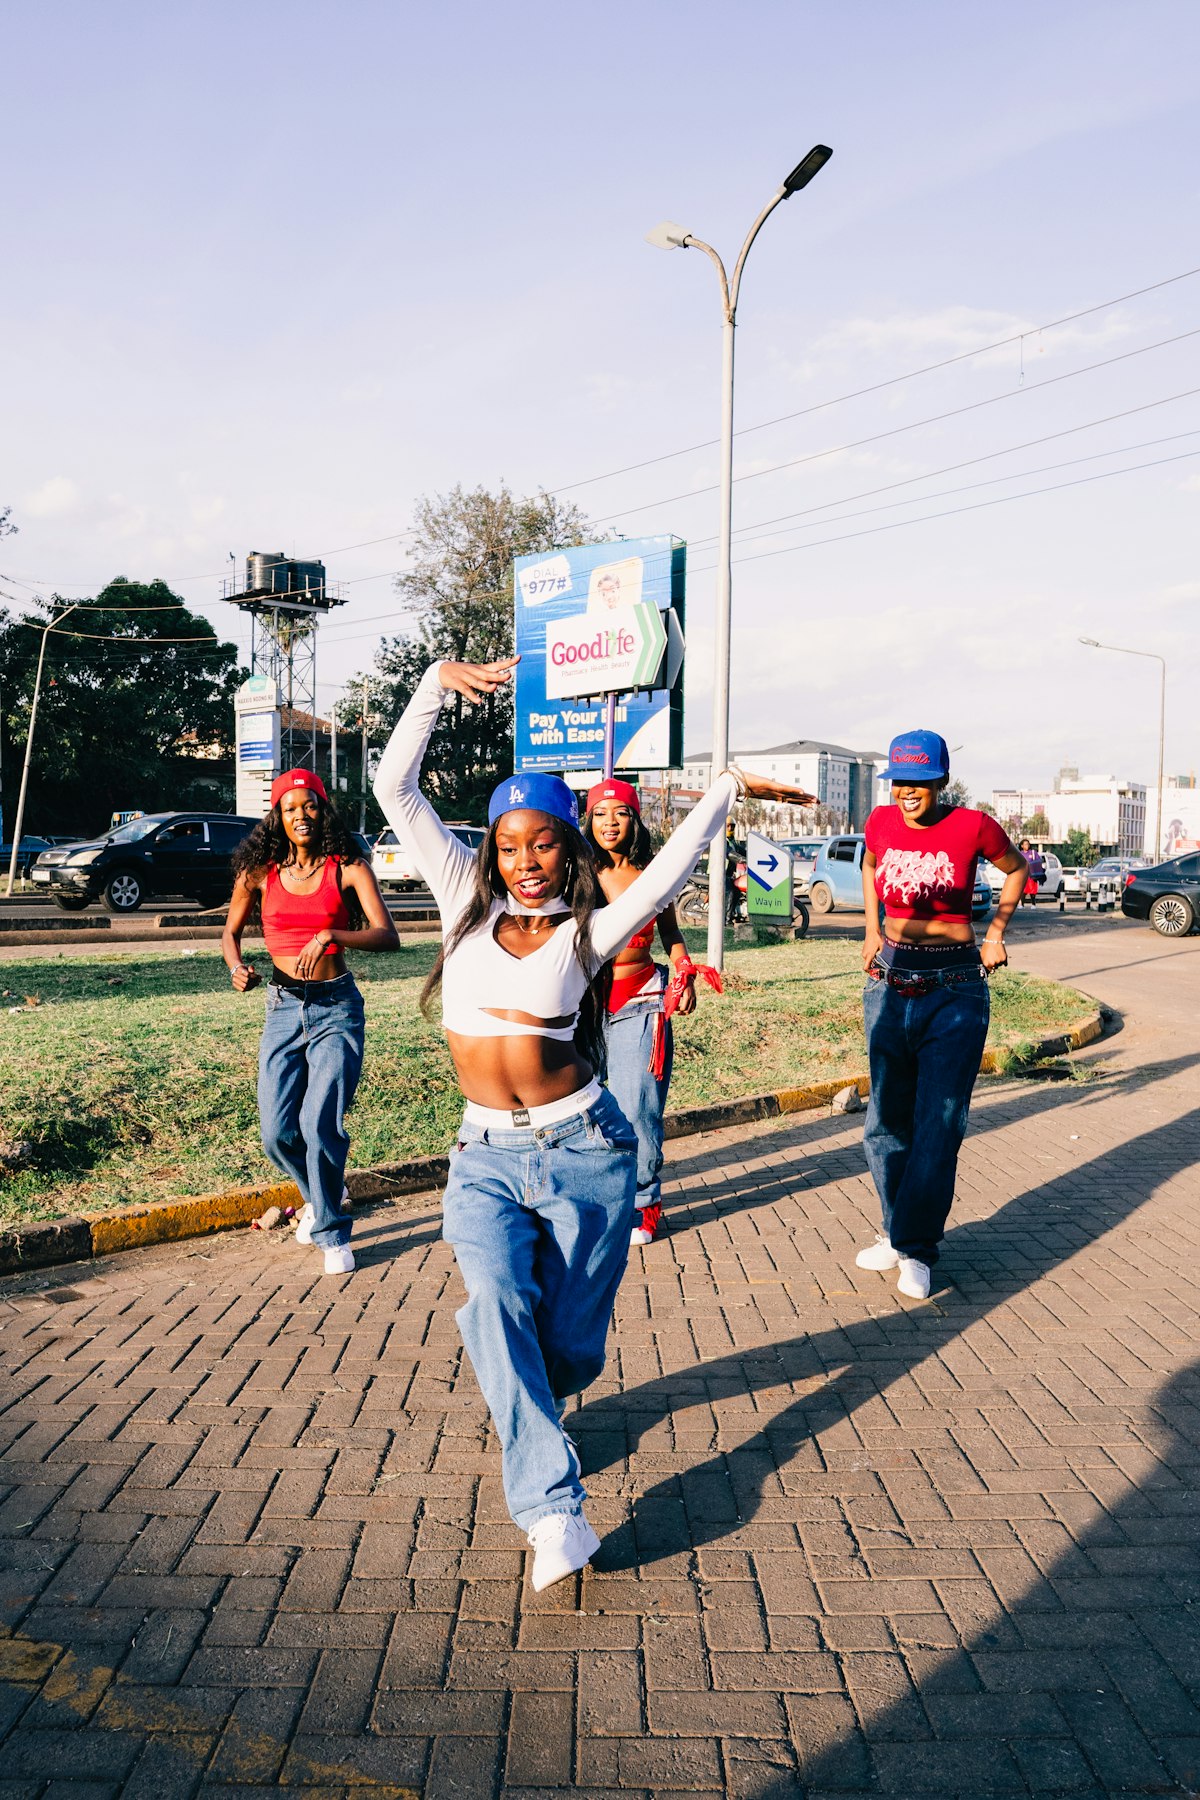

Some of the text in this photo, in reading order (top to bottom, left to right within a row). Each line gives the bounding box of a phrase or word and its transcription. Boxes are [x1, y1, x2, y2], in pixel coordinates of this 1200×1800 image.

[533, 568, 558, 578] DIAL
[551, 627, 634, 666] Goodlife
[529, 712, 558, 729] Pay
[560, 710, 598, 726] Your
[529, 728, 564, 746] with
[509, 785, 524, 804] LA
[755, 897, 783, 908] Way in
[924, 945, 956, 953] TOMMY
